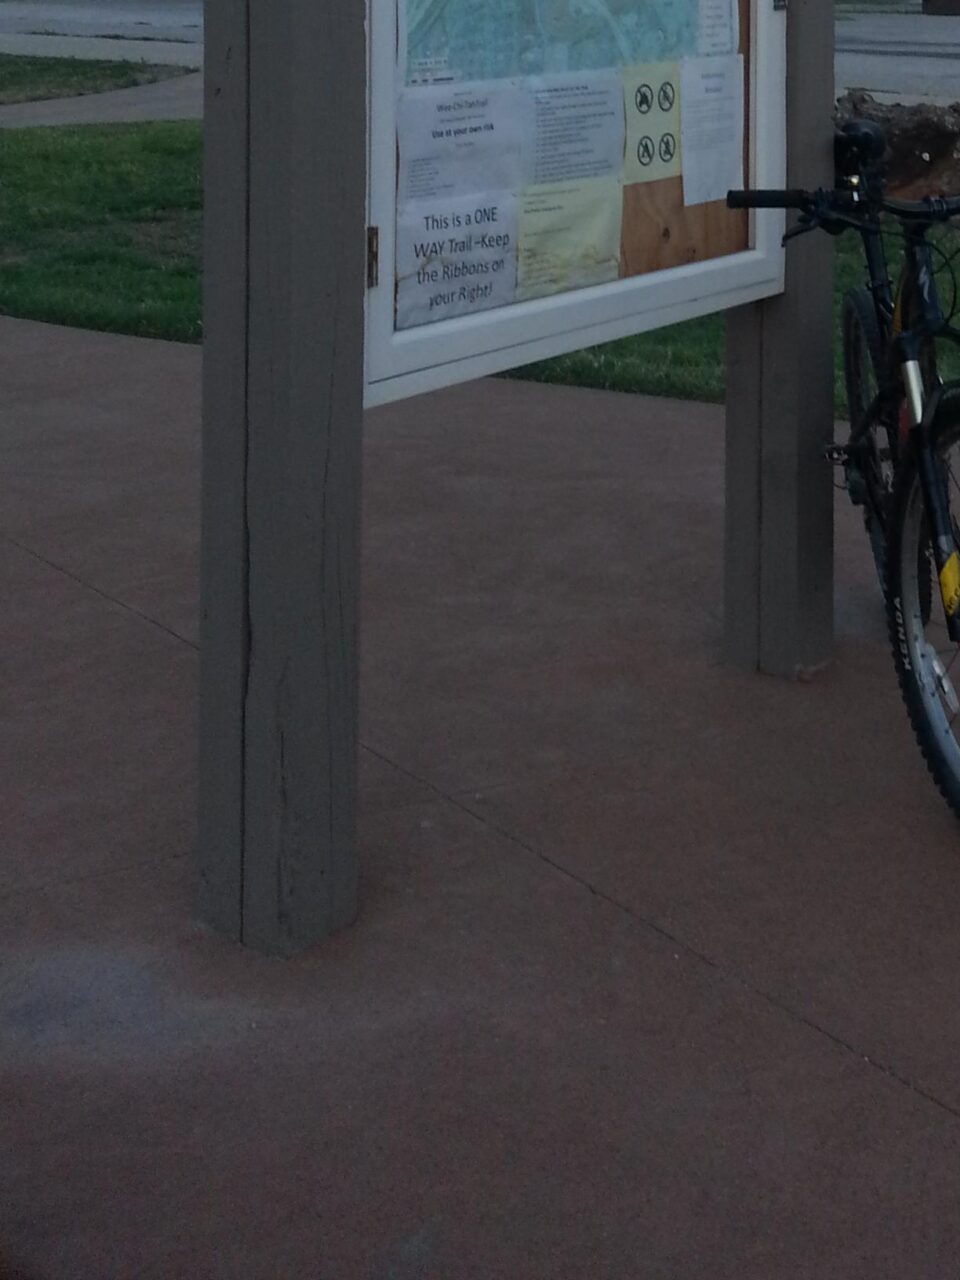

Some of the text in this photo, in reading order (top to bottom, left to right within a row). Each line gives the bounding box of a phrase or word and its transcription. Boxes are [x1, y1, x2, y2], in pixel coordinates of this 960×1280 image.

[423, 207, 498, 231] This is a ONE
[414, 240, 446, 259] WAY
[448, 235, 472, 254] Trail
[417, 267, 439, 285] the
[442, 262, 489, 281] Ribbons
[492, 258, 505, 273] on
[429, 281, 493, 311] your Right!
[894, 598, 911, 670] KENDA
